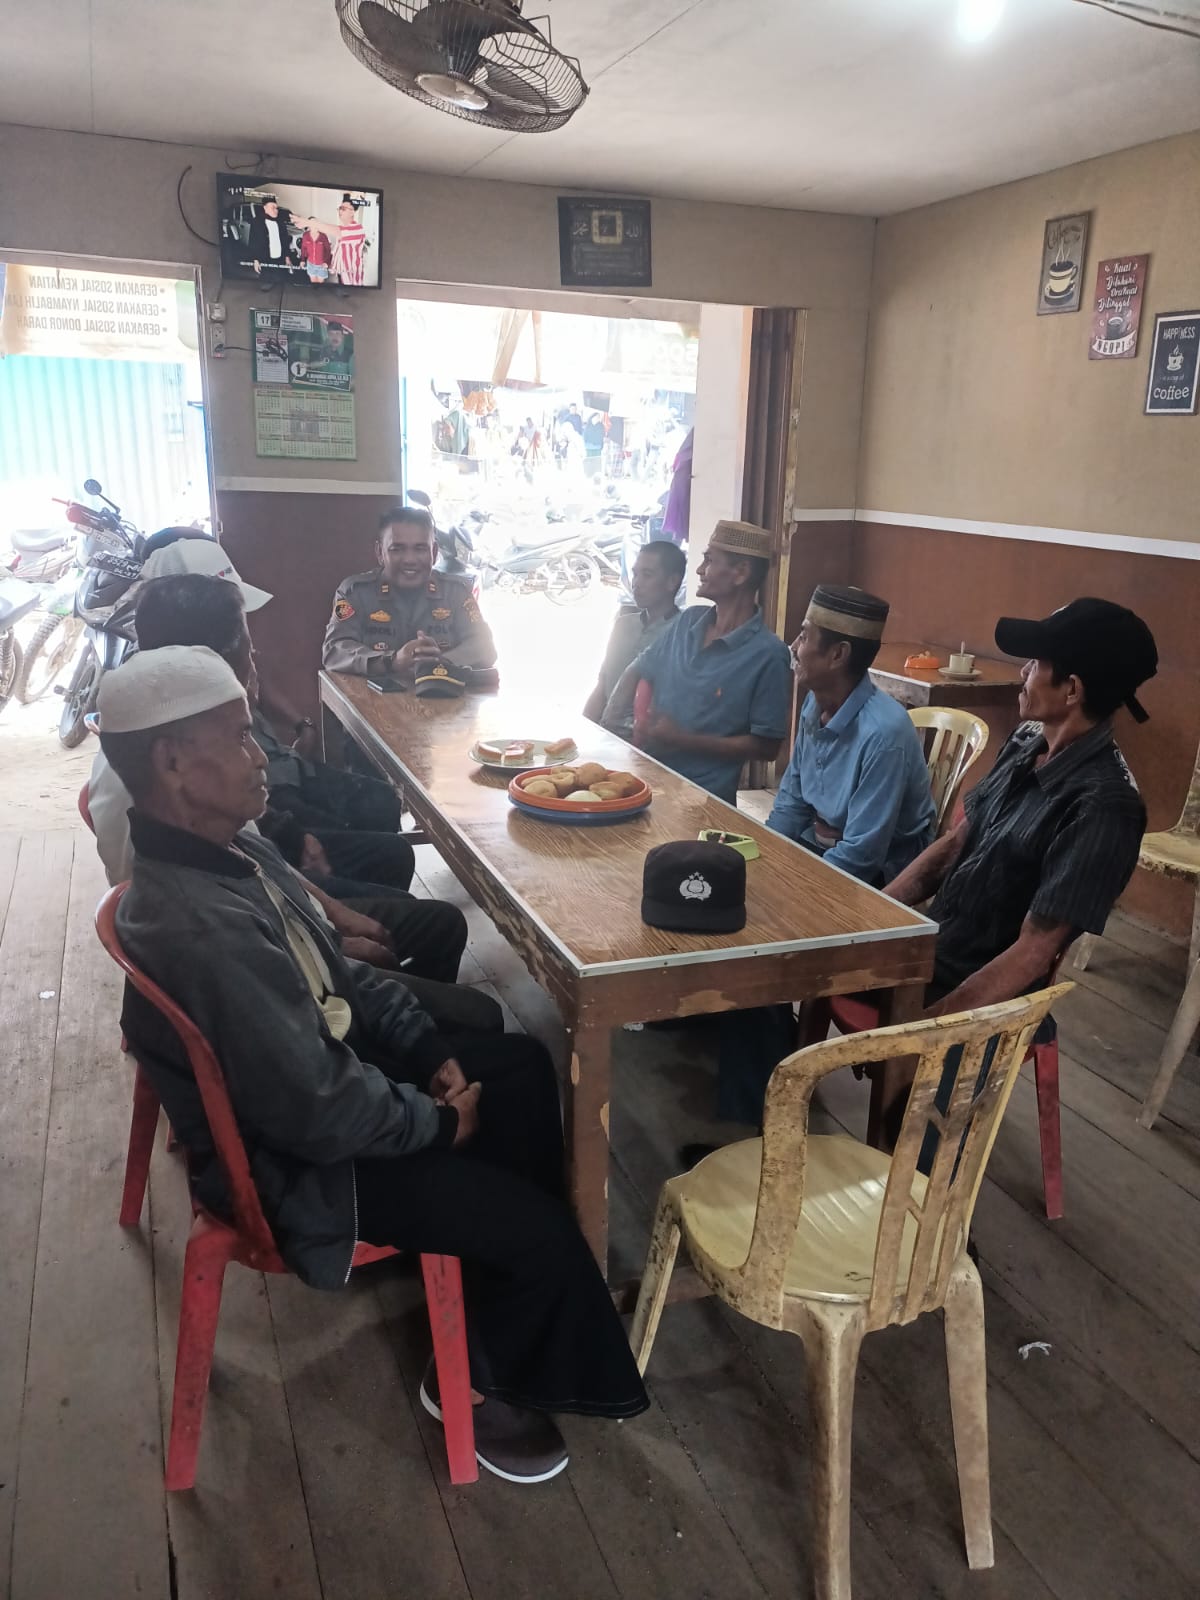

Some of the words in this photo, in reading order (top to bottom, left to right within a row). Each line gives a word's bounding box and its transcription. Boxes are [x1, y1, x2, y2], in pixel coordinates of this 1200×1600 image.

[261, 315, 270, 325] 17
[1163, 326, 1196, 340] HAPPINESS
[1153, 385, 1190, 401] coffee
